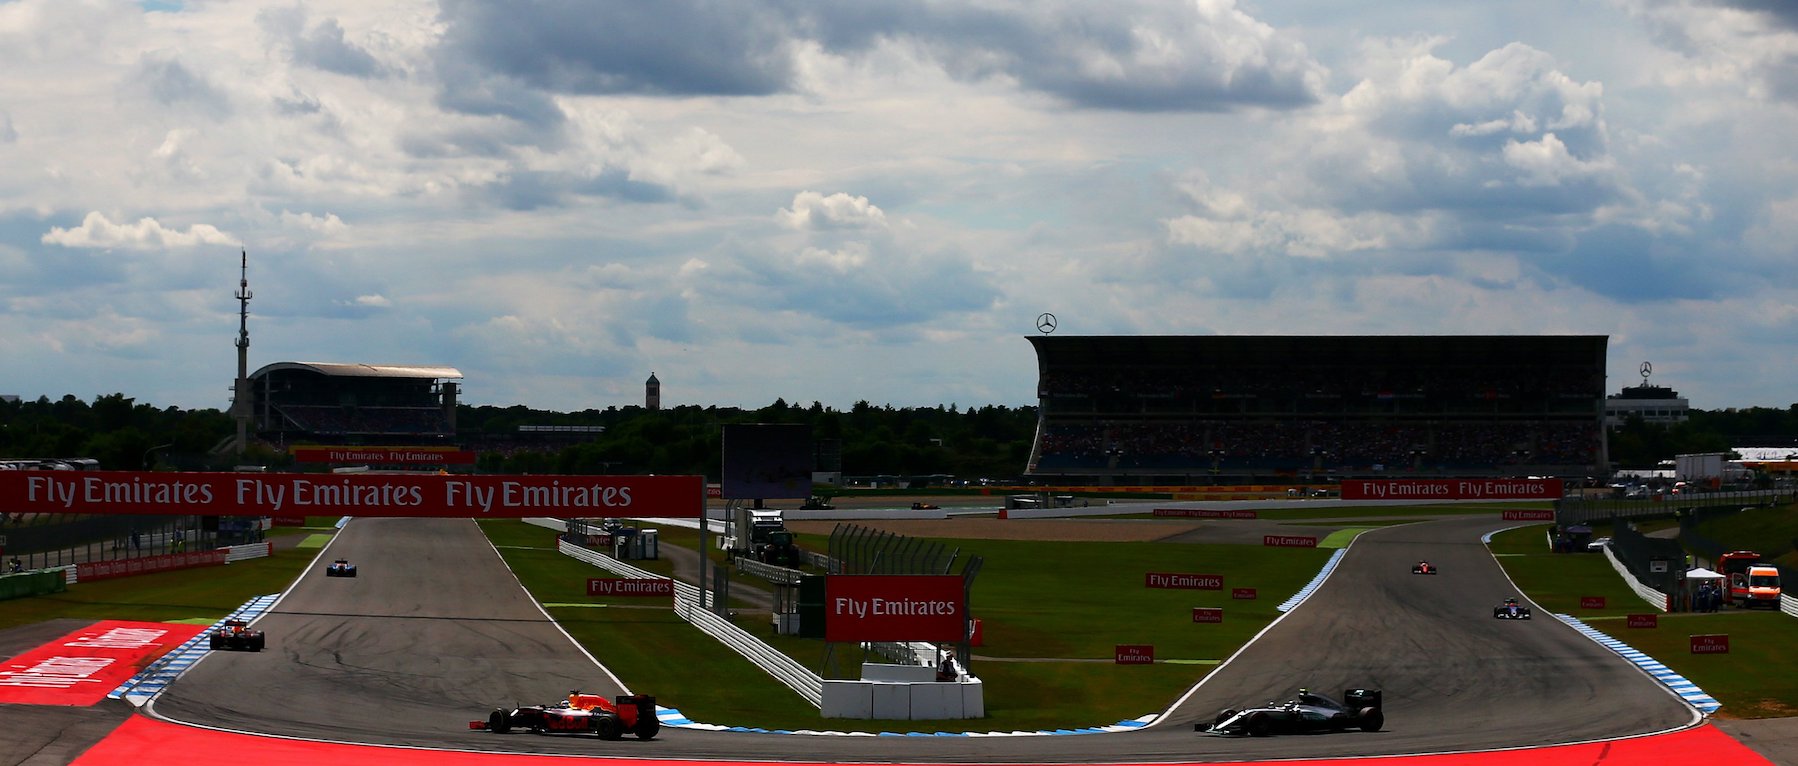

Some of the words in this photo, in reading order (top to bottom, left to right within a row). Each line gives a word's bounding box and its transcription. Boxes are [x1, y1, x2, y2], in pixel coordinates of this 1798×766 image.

[328, 452, 346, 461] Fly
[346, 451, 384, 461] Emirates
[389, 452, 404, 461] Fly
[405, 452, 444, 461] Emirates
[27, 477, 76, 508] Fly
[84, 477, 213, 503] Emirates
[236, 479, 285, 510] Fly
[293, 478, 422, 505] Emirates
[446, 480, 495, 512] Fly
[502, 480, 632, 506] Emirates
[1363, 482, 1387, 497] Fly
[1390, 482, 1449, 494] Emirates
[1459, 482, 1482, 497] Fly
[1486, 482, 1546, 494] Emirates
[1504, 511, 1517, 521] Fly
[1518, 512, 1552, 520] Emirates
[1266, 536, 1280, 545] Fly
[1281, 537, 1314, 546] Emirates
[592, 580, 613, 594] Fly
[615, 580, 670, 592] Emirates
[1150, 575, 1169, 587] Fly
[1171, 575, 1220, 587] Emirates
[836, 598, 867, 618] Fly
[872, 598, 955, 615] Emirates
[1693, 644, 1727, 653] Emirates
[1118, 653, 1151, 662] Emirates
